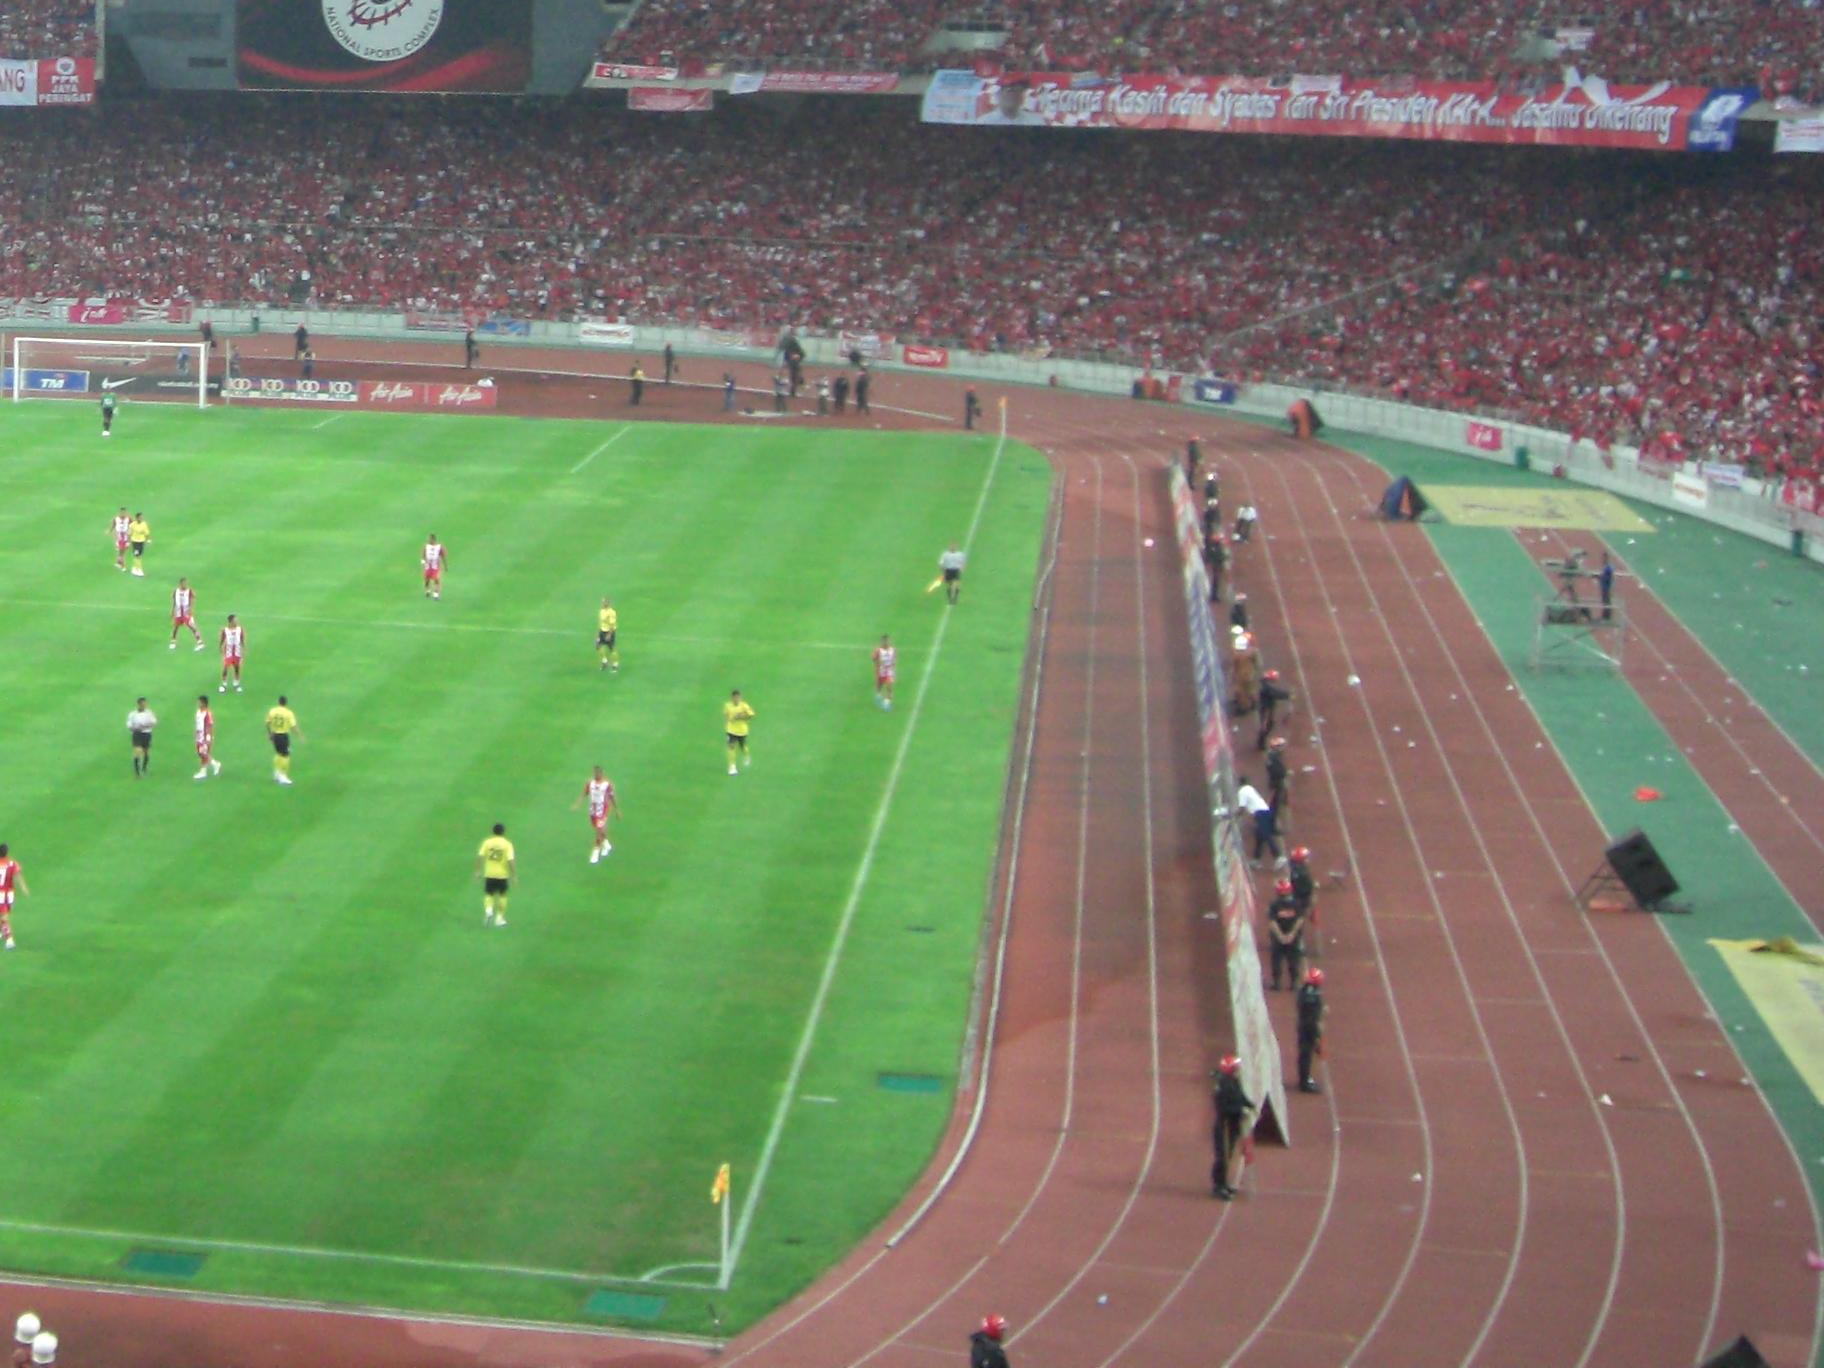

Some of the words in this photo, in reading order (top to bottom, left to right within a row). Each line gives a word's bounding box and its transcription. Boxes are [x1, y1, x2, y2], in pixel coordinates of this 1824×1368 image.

[327, 7, 361, 53] NATIONAL
[364, 47, 402, 58] SPORTS
[403, 8, 439, 51] COMPLEX
[1108, 84, 1167, 114] Kasih
[1168, 88, 1209, 115] dan
[1352, 89, 1438, 124] Presiden
[40, 378, 65, 389] TM
